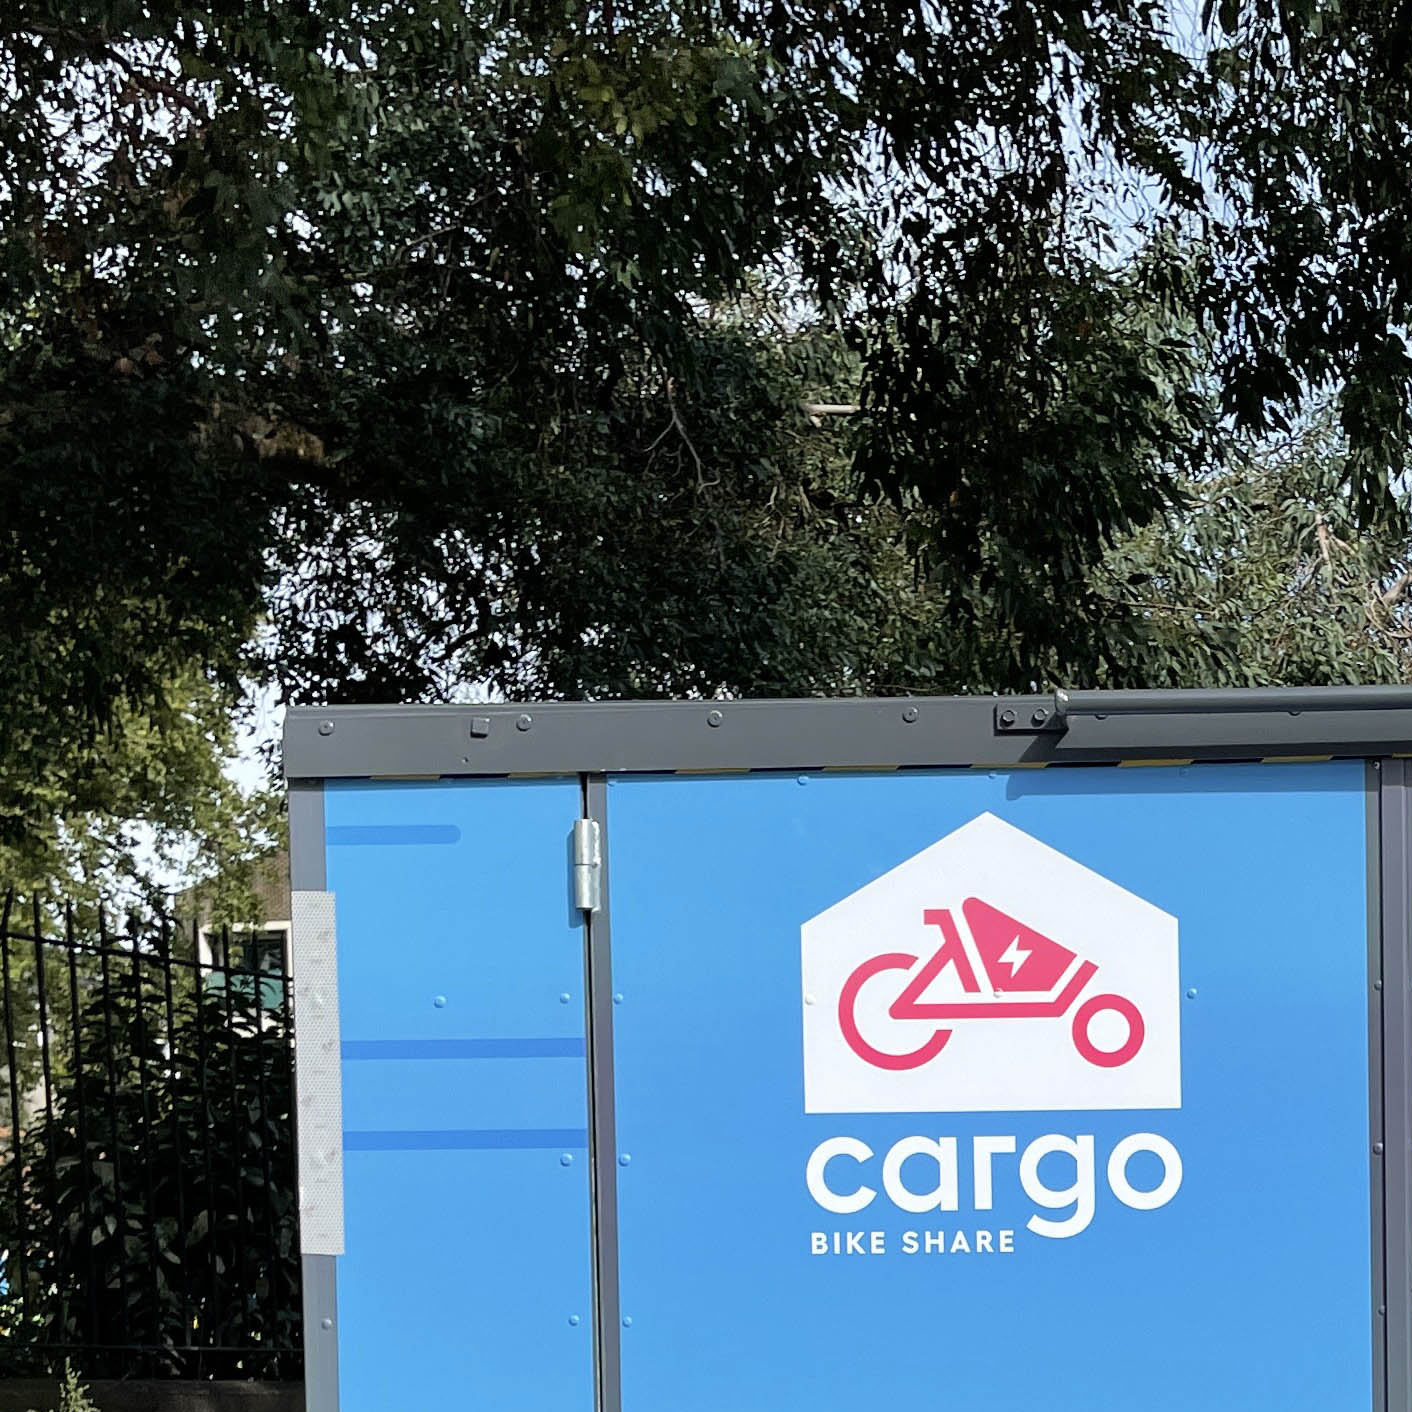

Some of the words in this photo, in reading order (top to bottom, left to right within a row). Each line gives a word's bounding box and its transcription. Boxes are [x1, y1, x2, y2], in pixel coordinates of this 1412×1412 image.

[805, 1132, 1184, 1239] cargo
[810, 1231, 886, 1255] BIKE
[901, 1230, 1015, 1255] SHARE
